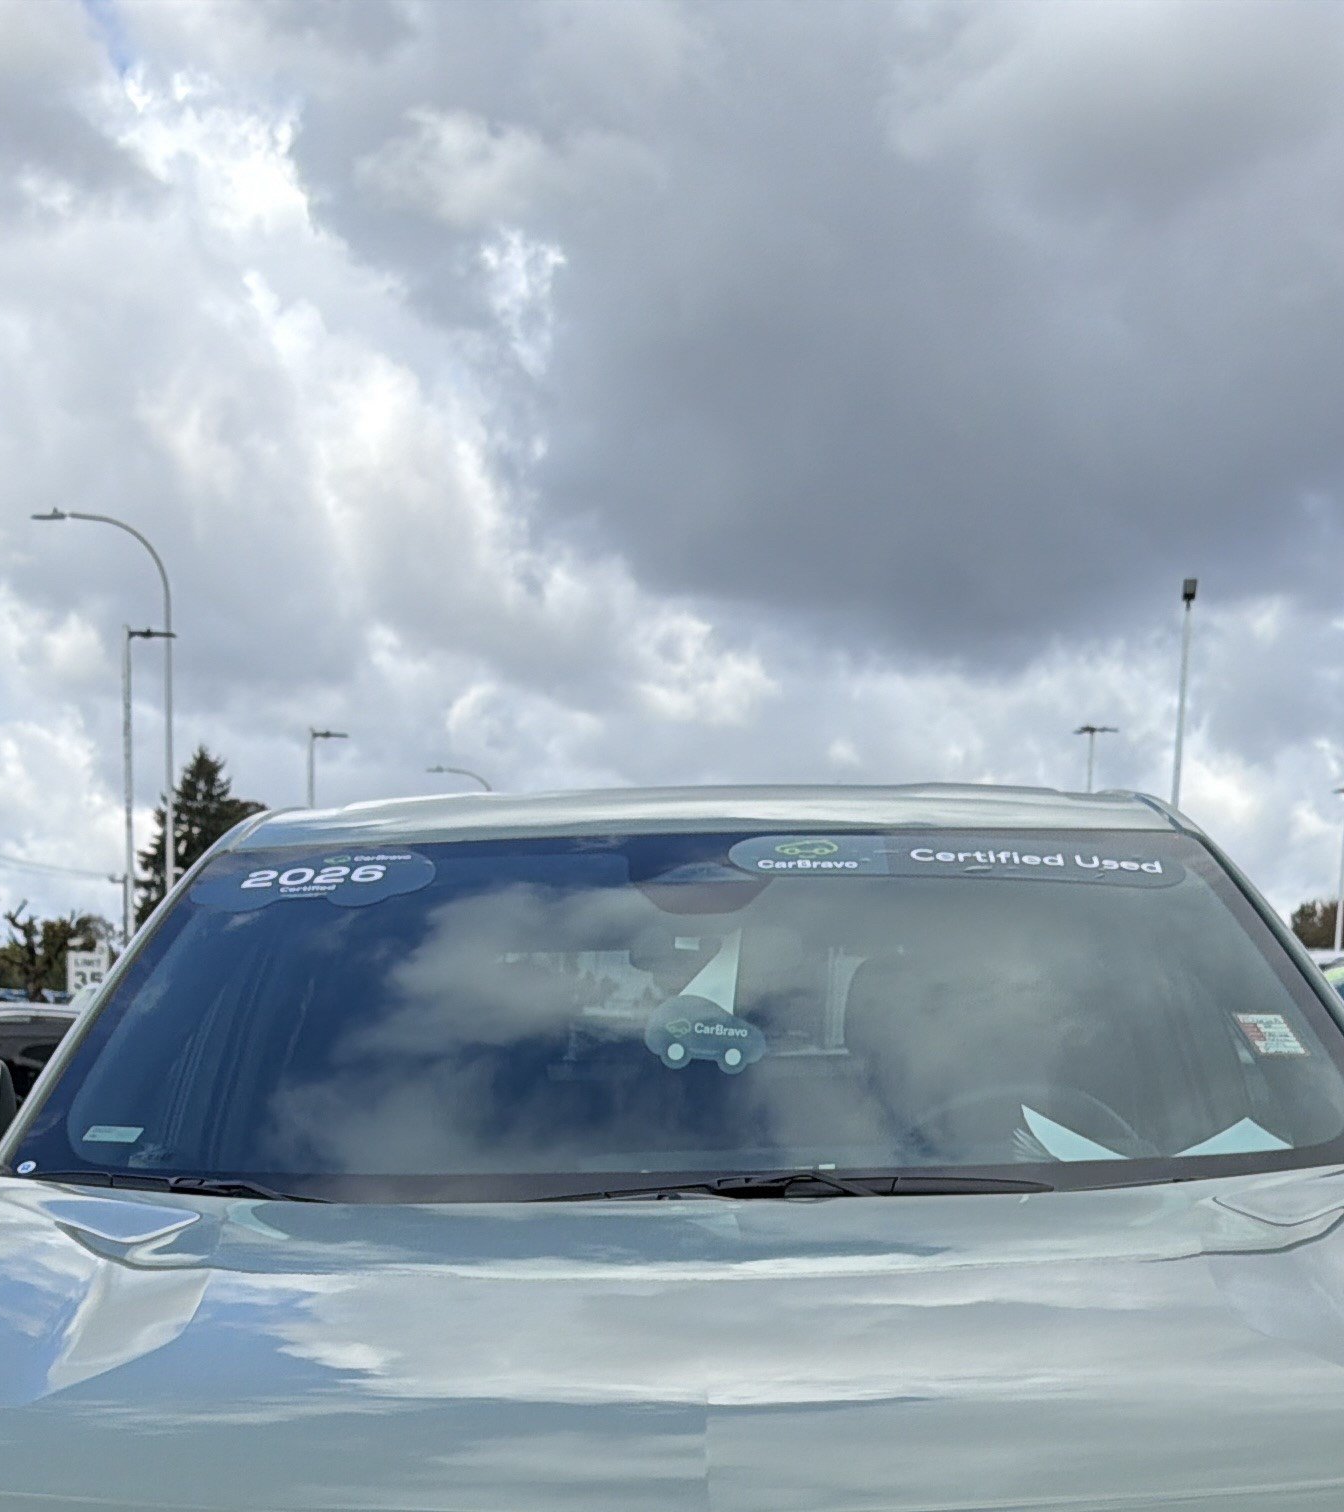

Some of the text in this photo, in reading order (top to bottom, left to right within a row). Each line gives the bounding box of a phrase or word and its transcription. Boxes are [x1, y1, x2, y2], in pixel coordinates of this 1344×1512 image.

[757, 859, 858, 869] CarBravo
[910, 848, 1163, 874] Certified Used
[241, 864, 387, 889] 2026
[694, 1022, 748, 1038] CarBravo
